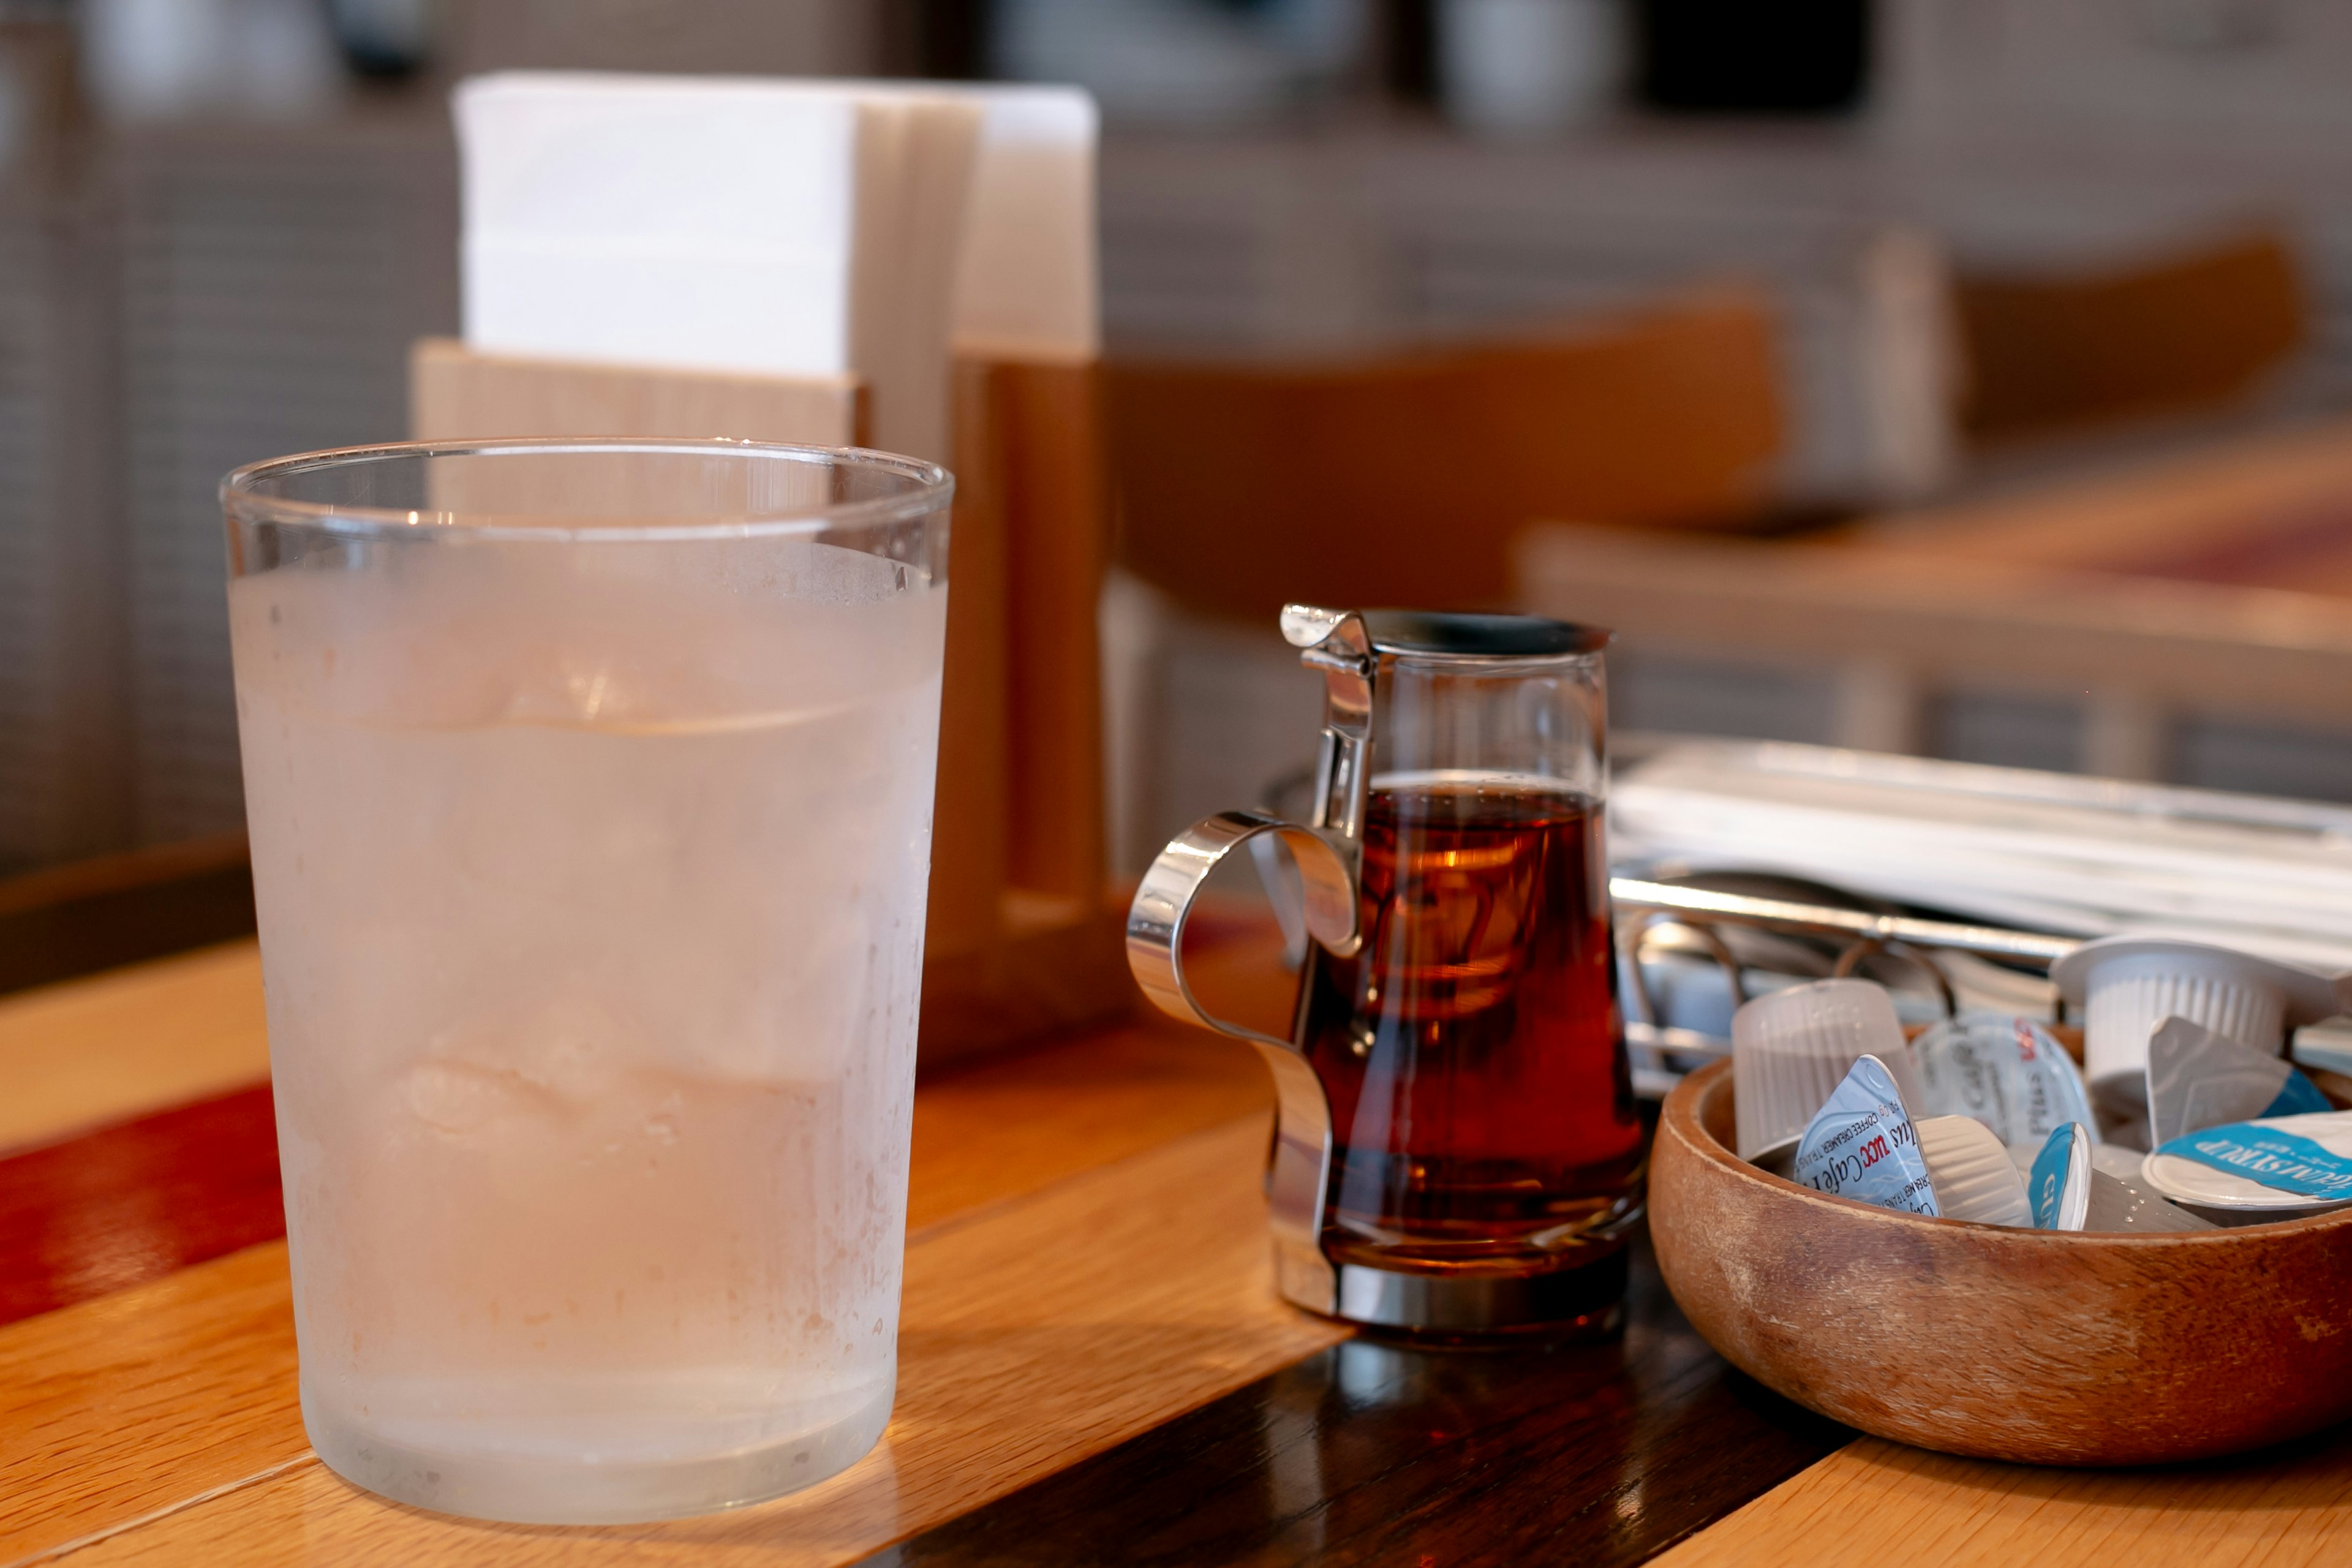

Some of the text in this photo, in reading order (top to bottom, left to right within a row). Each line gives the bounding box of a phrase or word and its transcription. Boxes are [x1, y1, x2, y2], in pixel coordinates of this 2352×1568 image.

[1852, 1112, 1879, 1134] COFFEE
[1890, 1120, 1917, 1148] lus
[1822, 1128, 1853, 1154] CREAMER
[2195, 1139, 2293, 1174] SYRUP
[1822, 1155, 1863, 1194] Café
